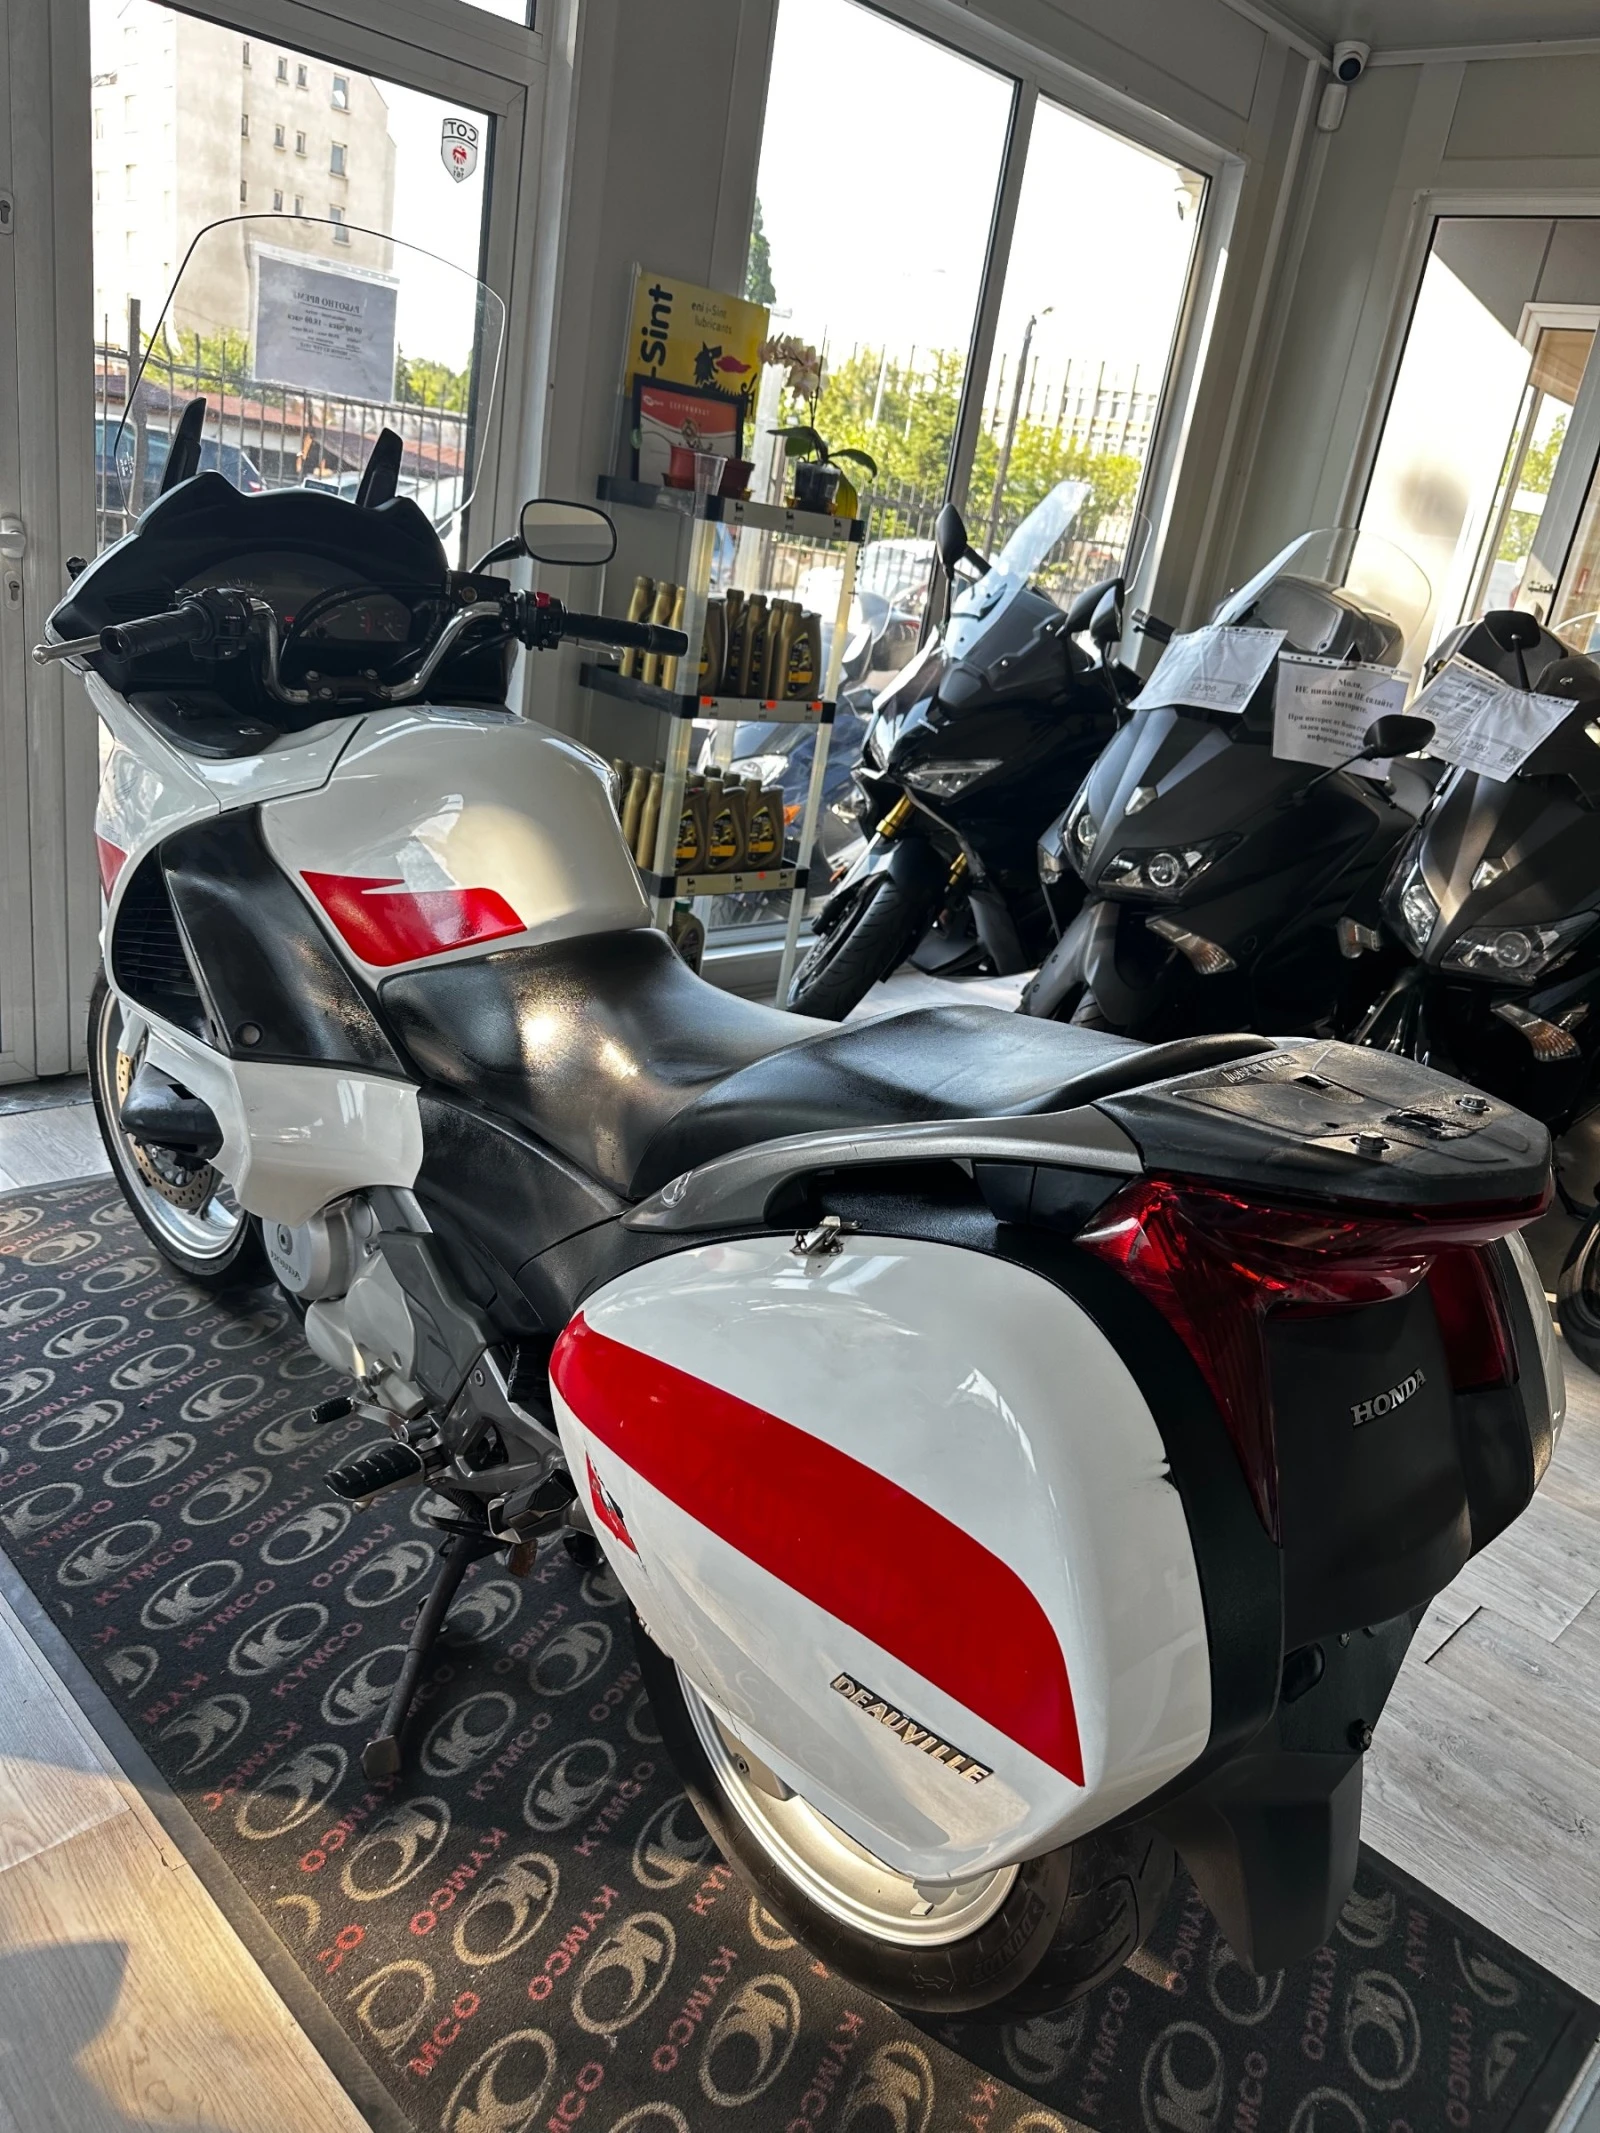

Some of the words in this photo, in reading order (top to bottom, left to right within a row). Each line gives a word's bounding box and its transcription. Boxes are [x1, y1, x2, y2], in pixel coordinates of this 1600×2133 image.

[641, 284, 673, 378] -Sint
[694, 316, 732, 335] lubricants
[59, 1184, 119, 1212] KYMC
[57, 1245, 134, 1281] KYMCO
[120, 1278, 182, 1307] YMCO
[7, 1300, 92, 1342] KYMCO
[72, 1328, 154, 1373] KYMCO
[184, 1311, 233, 1337] MCO
[252, 1333, 306, 1366] YMCO
[1, 1385, 94, 1436] KYMCO
[142, 1358, 222, 1404] KYMCO
[1350, 1368, 1426, 1428] HONDA
[213, 1388, 292, 1437] KYMCO
[72, 1418, 165, 1471] KYMCO
[288, 1419, 363, 1471] KYMCO
[150, 1451, 239, 1507] KYMCO
[228, 1485, 314, 1547] KYMCO
[94, 1537, 193, 1607] KYMCO
[311, 1523, 395, 1589] KYMCO
[180, 1579, 276, 1650] KYMCO
[271, 1622, 364, 1697] KYMCO
[143, 1672, 208, 1725] KYM
[468, 1711, 553, 1800] KYMCO
[832, 1674, 992, 1785] DEAUVILLE
[574, 1760, 656, 1857] KYMCO
[410, 1828, 509, 1935] KYMCO
[528, 1884, 619, 2000] KYMCO
[1405, 1909, 1430, 1975] KYM
[408, 1991, 480, 2076] MCO
[652, 1946, 738, 2073] KYMCO
[1302, 1947, 1337, 2061] KYMCO
